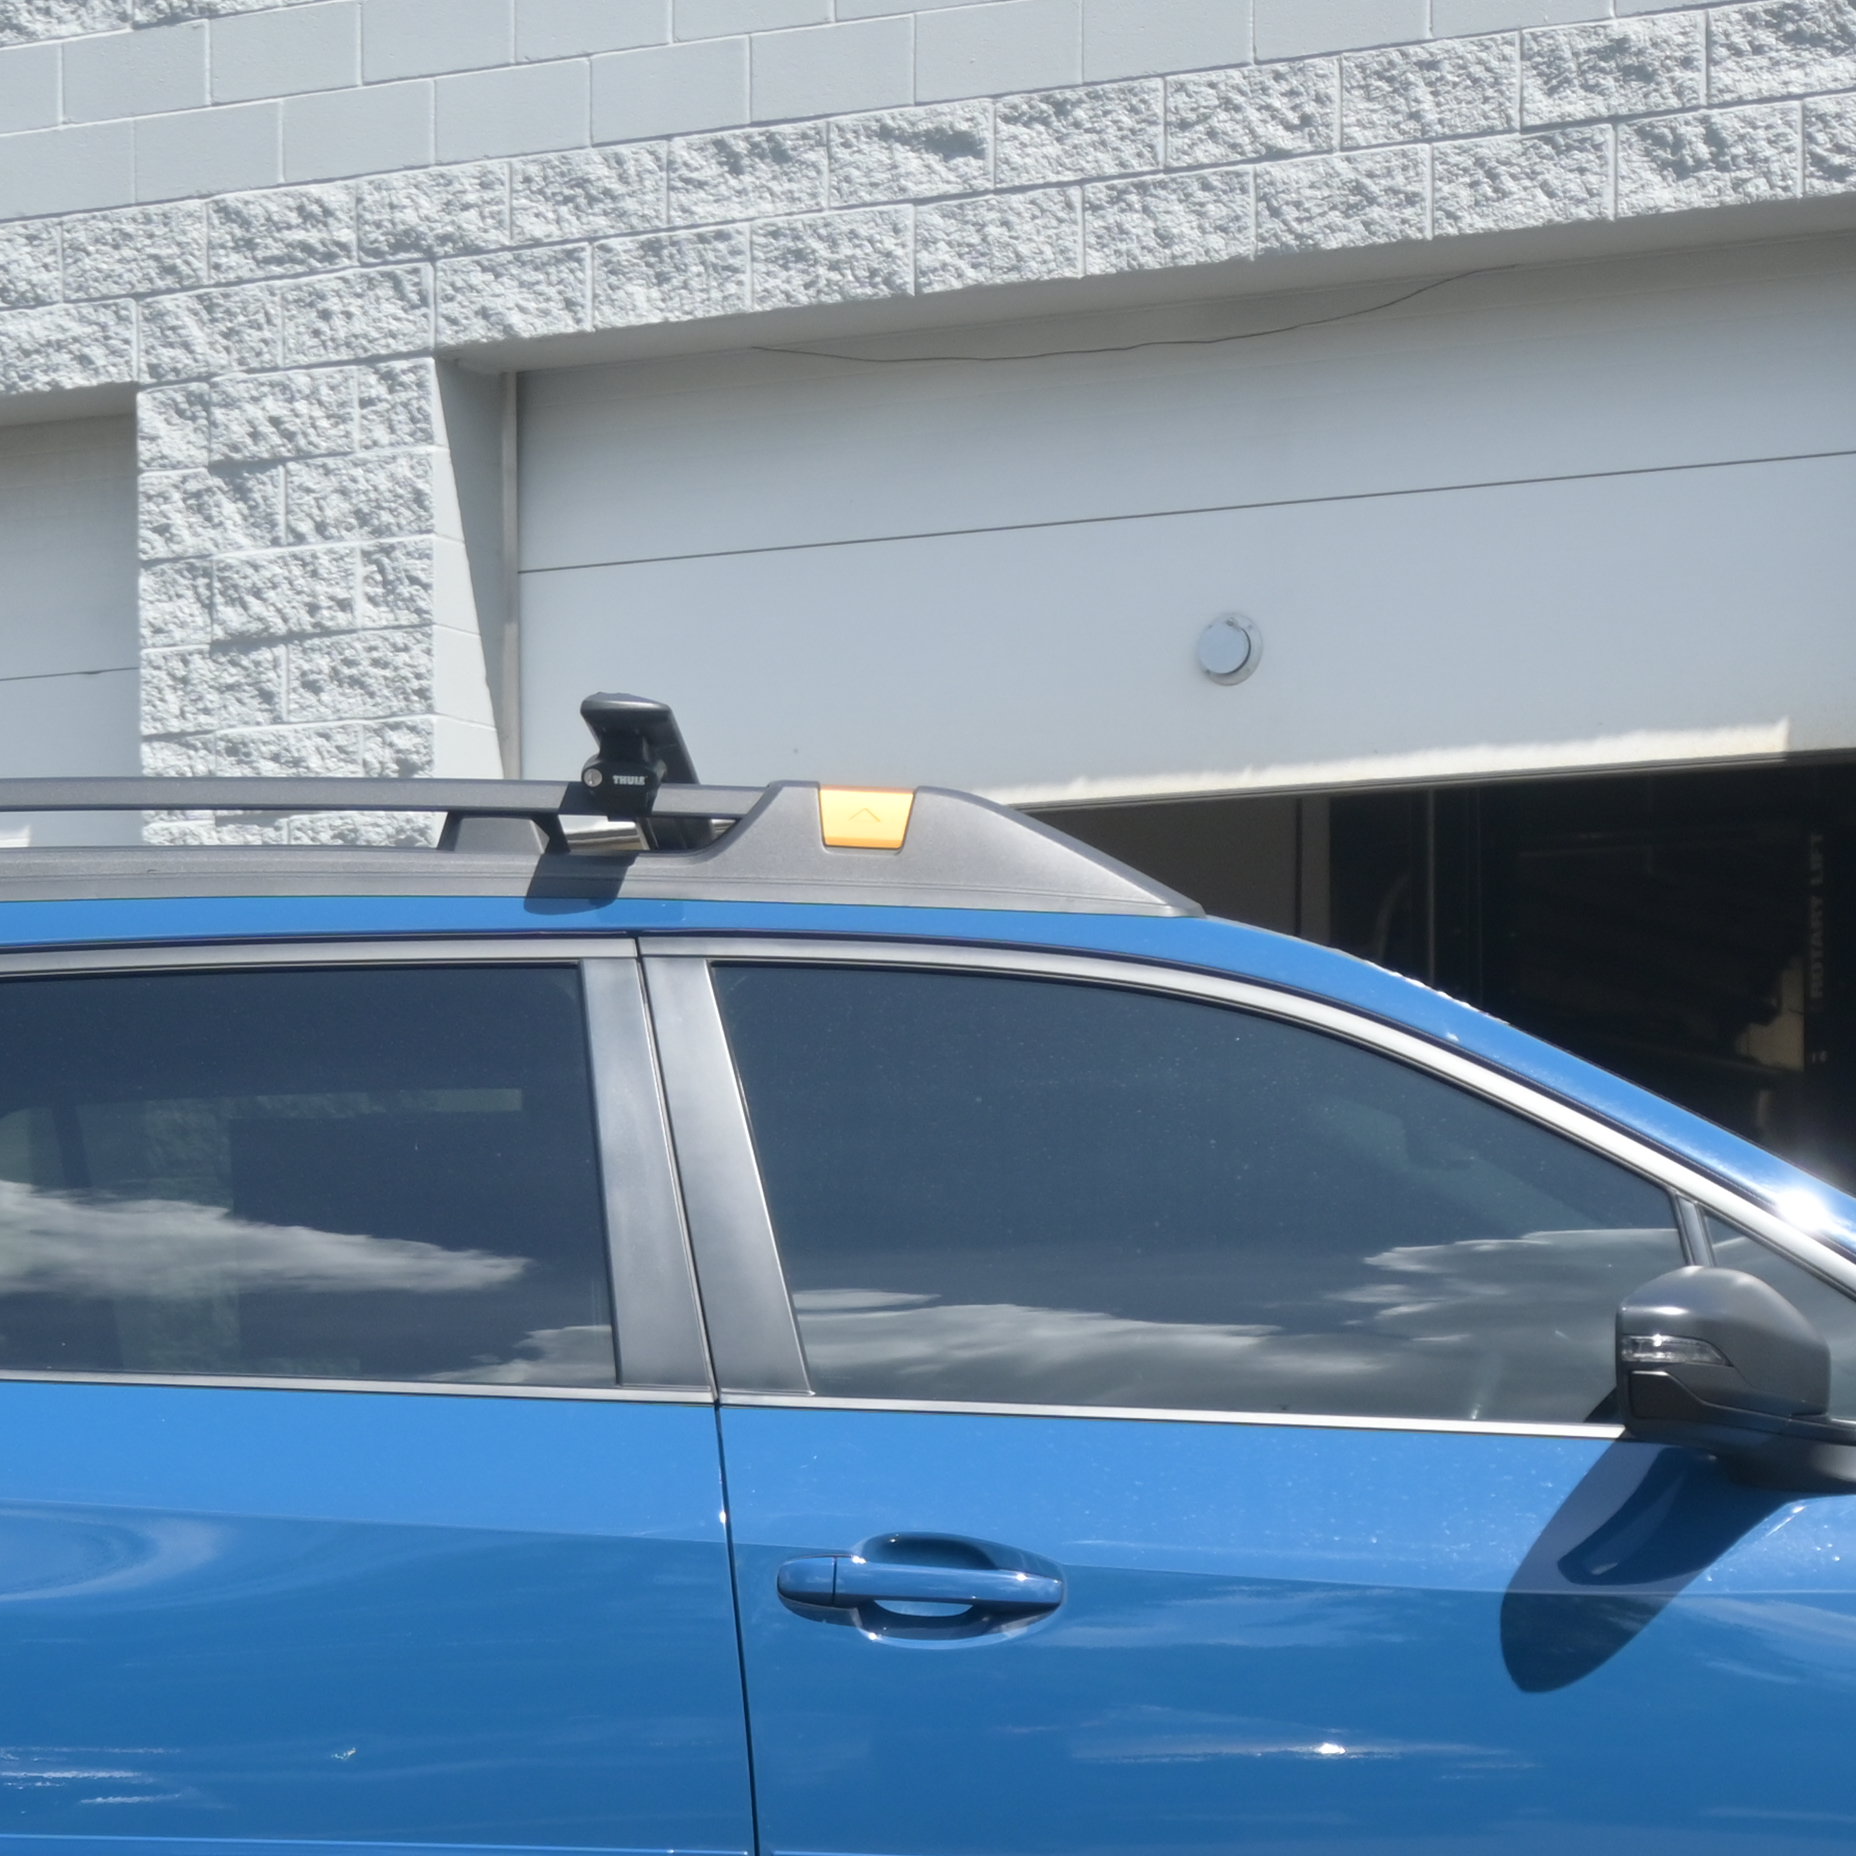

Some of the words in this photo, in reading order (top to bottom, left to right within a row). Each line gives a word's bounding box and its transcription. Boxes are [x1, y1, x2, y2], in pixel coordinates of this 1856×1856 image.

[613, 775, 646, 785] THULE
[1809, 834, 1824, 885] LIFT
[1809, 896, 1824, 999] ROTARY
